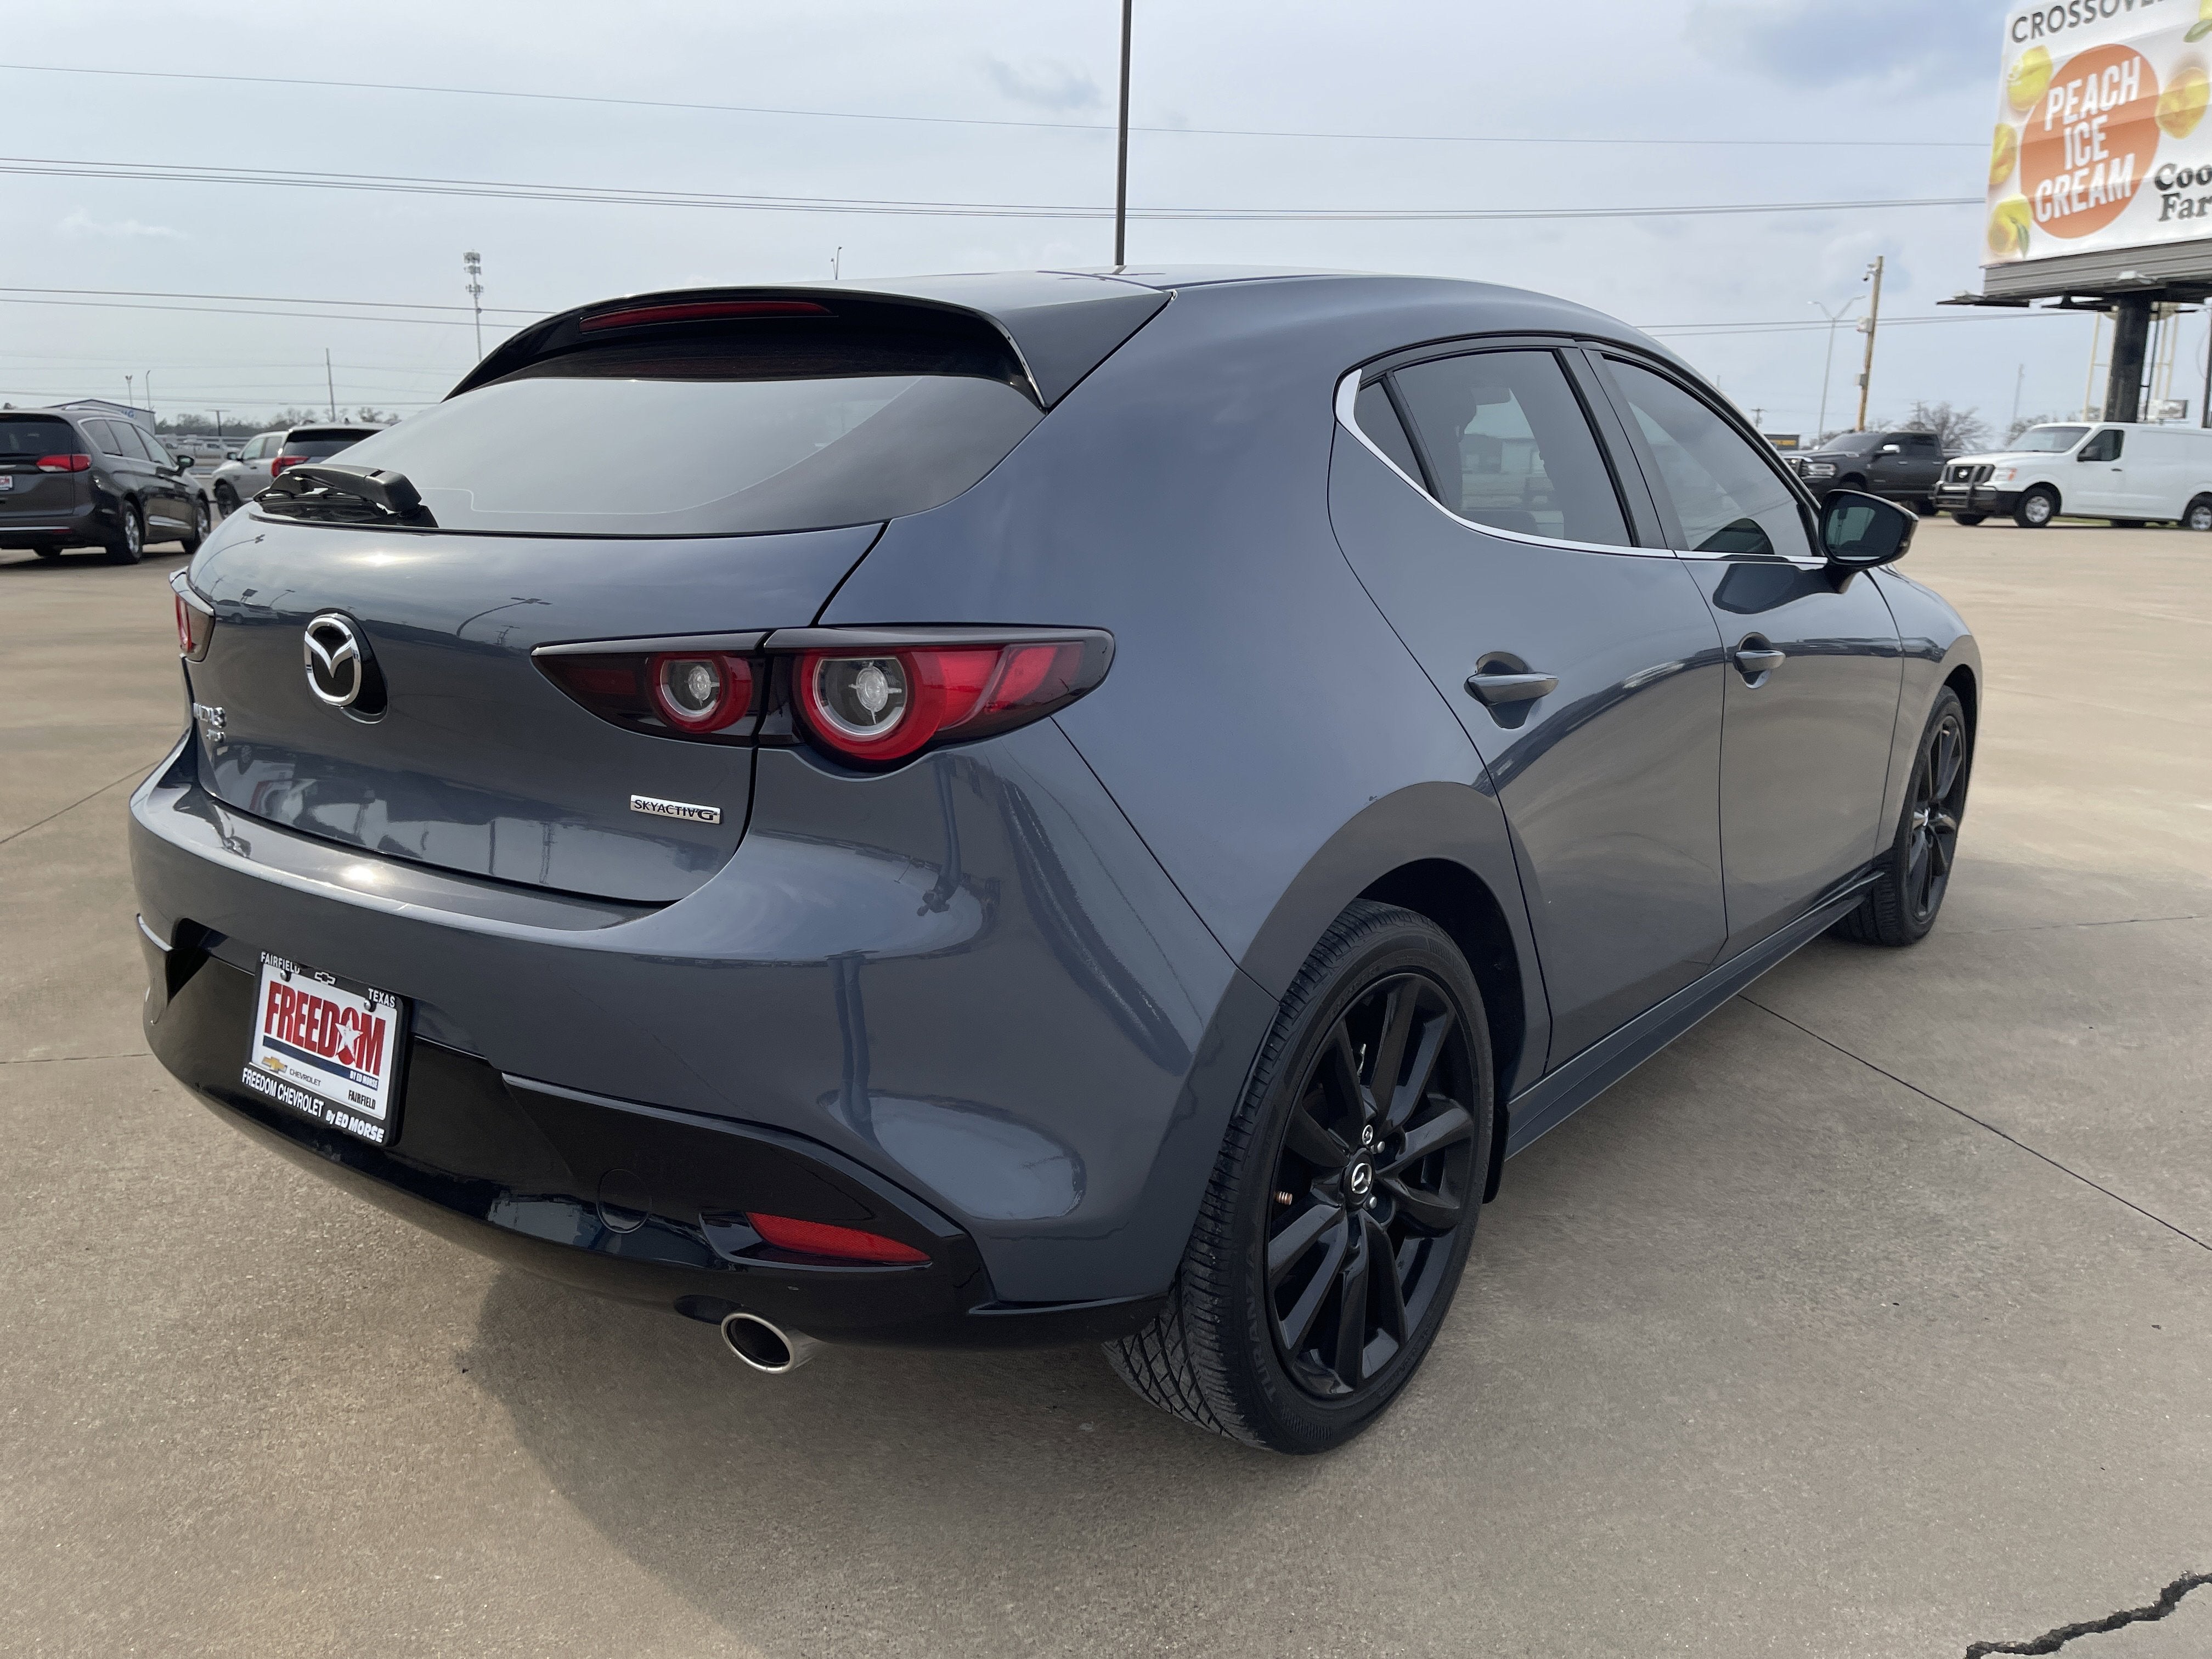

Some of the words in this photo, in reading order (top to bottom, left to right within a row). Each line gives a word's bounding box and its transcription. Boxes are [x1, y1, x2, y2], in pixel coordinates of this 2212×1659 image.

[2012, 0, 2164, 43] CROSSO
[2044, 57, 2141, 132] PEACH
[2063, 116, 2109, 170] ICE
[2034, 153, 2135, 222] CREAM
[261, 952, 300, 974] FAIRFIELD
[368, 988, 396, 1008] TEXAS
[264, 980, 386, 1076] FREEDOM
[290, 1069, 321, 1086] CHEVROLET
[348, 1090, 376, 1110] FAIRFIELD
[356, 1073, 363, 1082] ED
[362, 1075, 378, 1088] MORSE
[242, 1068, 278, 1097] FREEDOM
[277, 1083, 325, 1117] CHEVROLET
[335, 1111, 348, 1129] ED
[348, 1116, 385, 1143] MORSE
